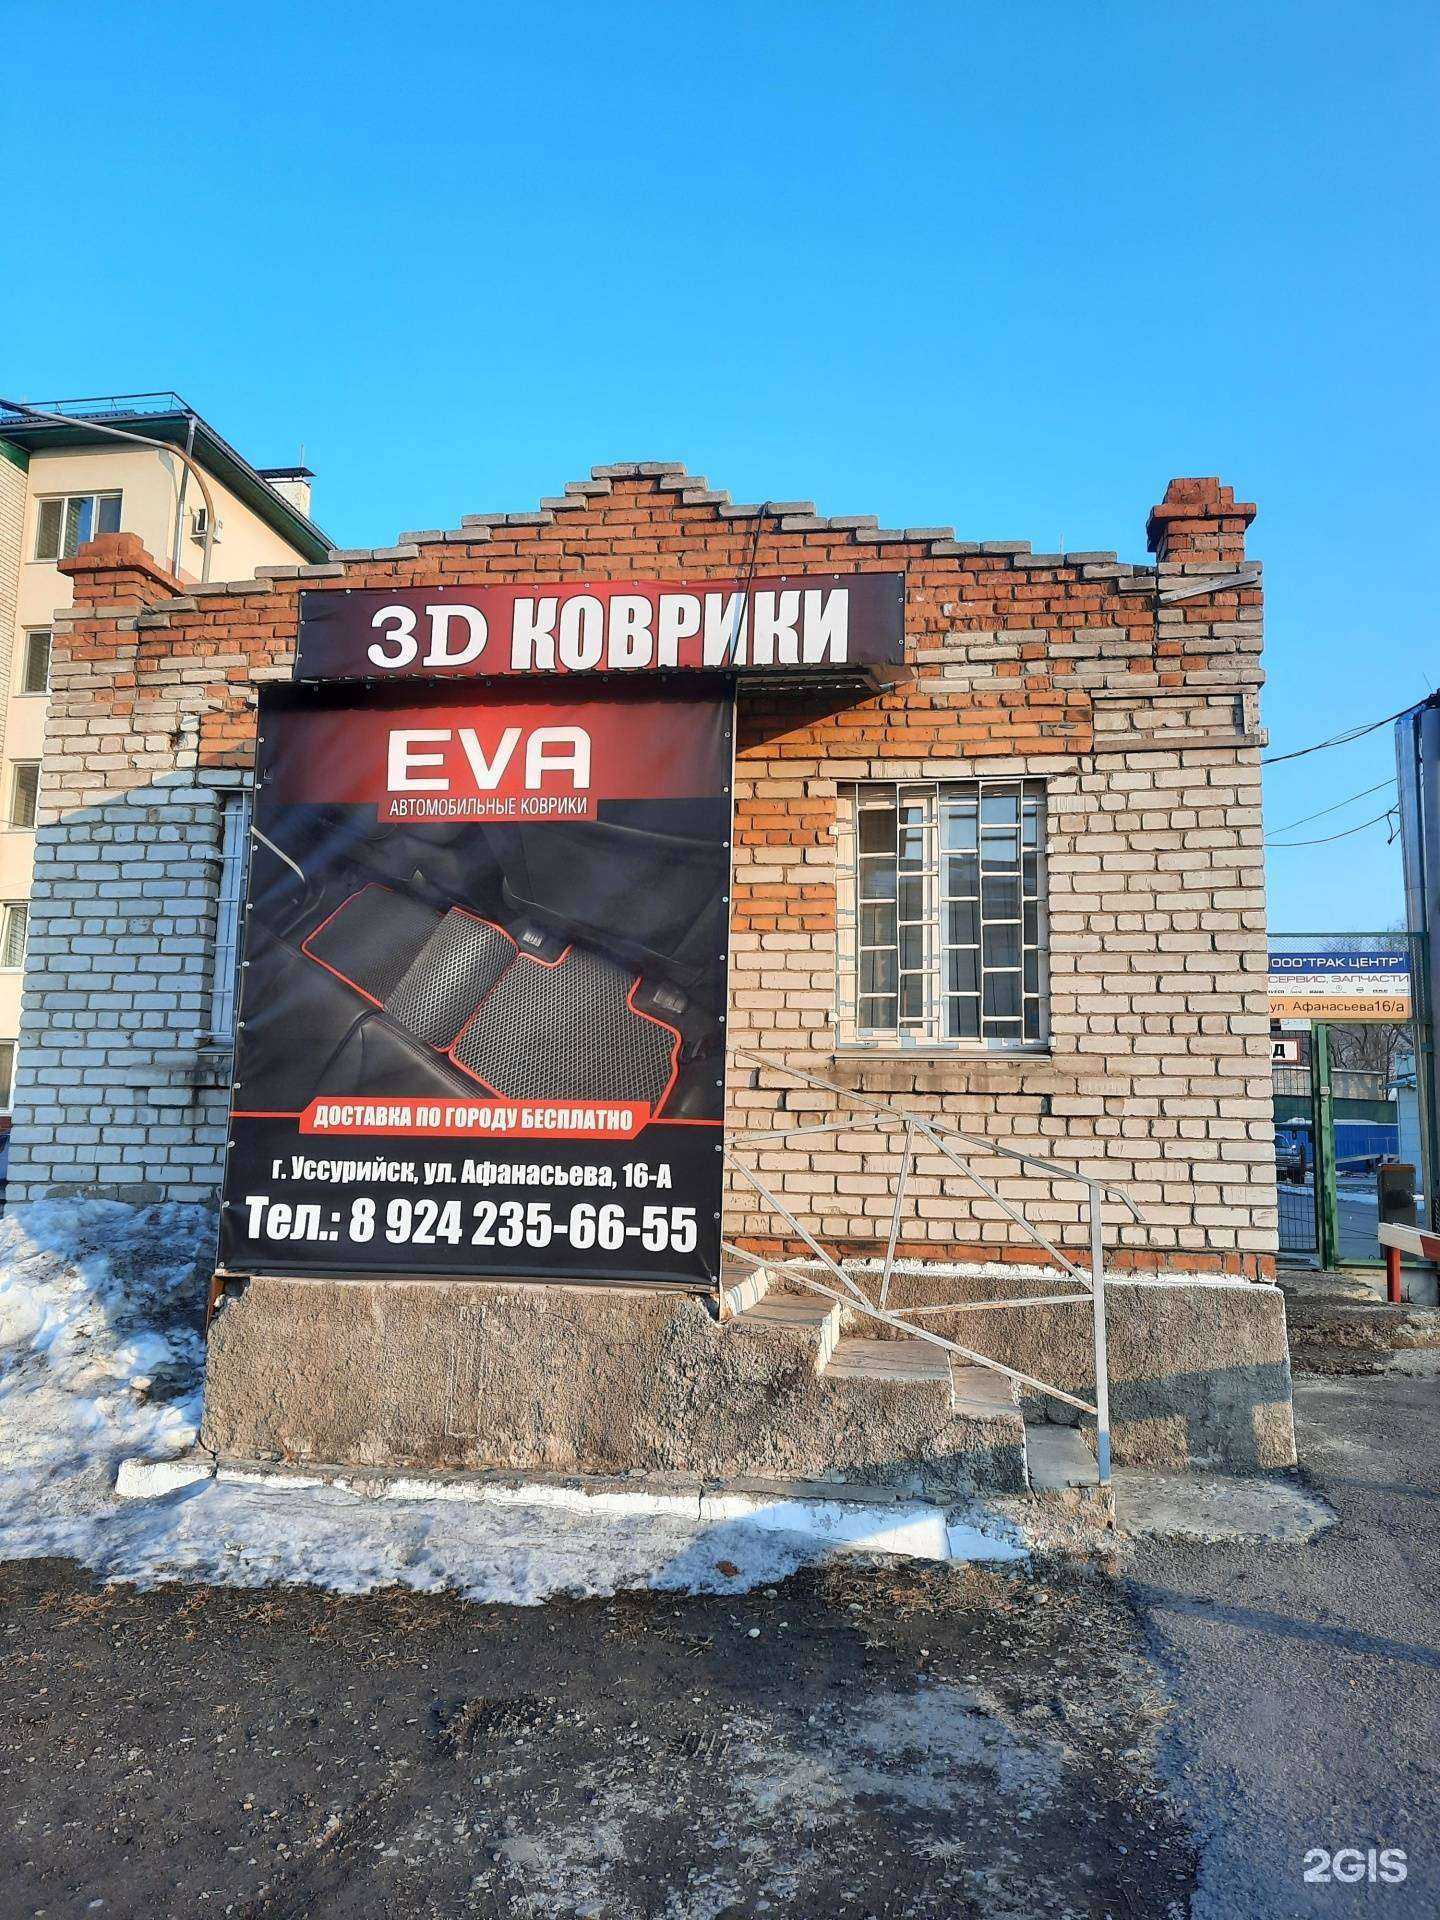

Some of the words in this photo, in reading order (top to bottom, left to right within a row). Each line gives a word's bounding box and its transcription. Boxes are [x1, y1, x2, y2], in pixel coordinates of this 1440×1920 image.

[367, 604, 489, 669] 3D
[511, 588, 850, 671] КОВРИКИ
[386, 726, 592, 792] EVA
[389, 797, 516, 817] АВТОМОБИЛЬНЫЕ
[520, 796, 588, 815] КОВРИКИ
[1331, 975, 1409, 983] ЗАПЧАСТИ
[1270, 1003, 1287, 1014] ул.
[313, 1105, 412, 1127] ДОСТАВКА
[416, 1106, 442, 1127] ПО
[445, 1107, 517, 1132] ГОРОДУ
[521, 1108, 634, 1131] БЕСПЛАТНО
[271, 1160, 287, 1180] г.
[291, 1155, 419, 1185] Уссурийск,
[423, 1163, 457, 1187] ул.
[461, 1158, 618, 1190] Афанасьева,
[622, 1163, 672, 1189] 16-А
[245, 1196, 339, 1242] Тел.:
[349, 1197, 378, 1244] 8
[386, 1199, 463, 1246] 924
[471, 1201, 698, 1253] 235-66-55
